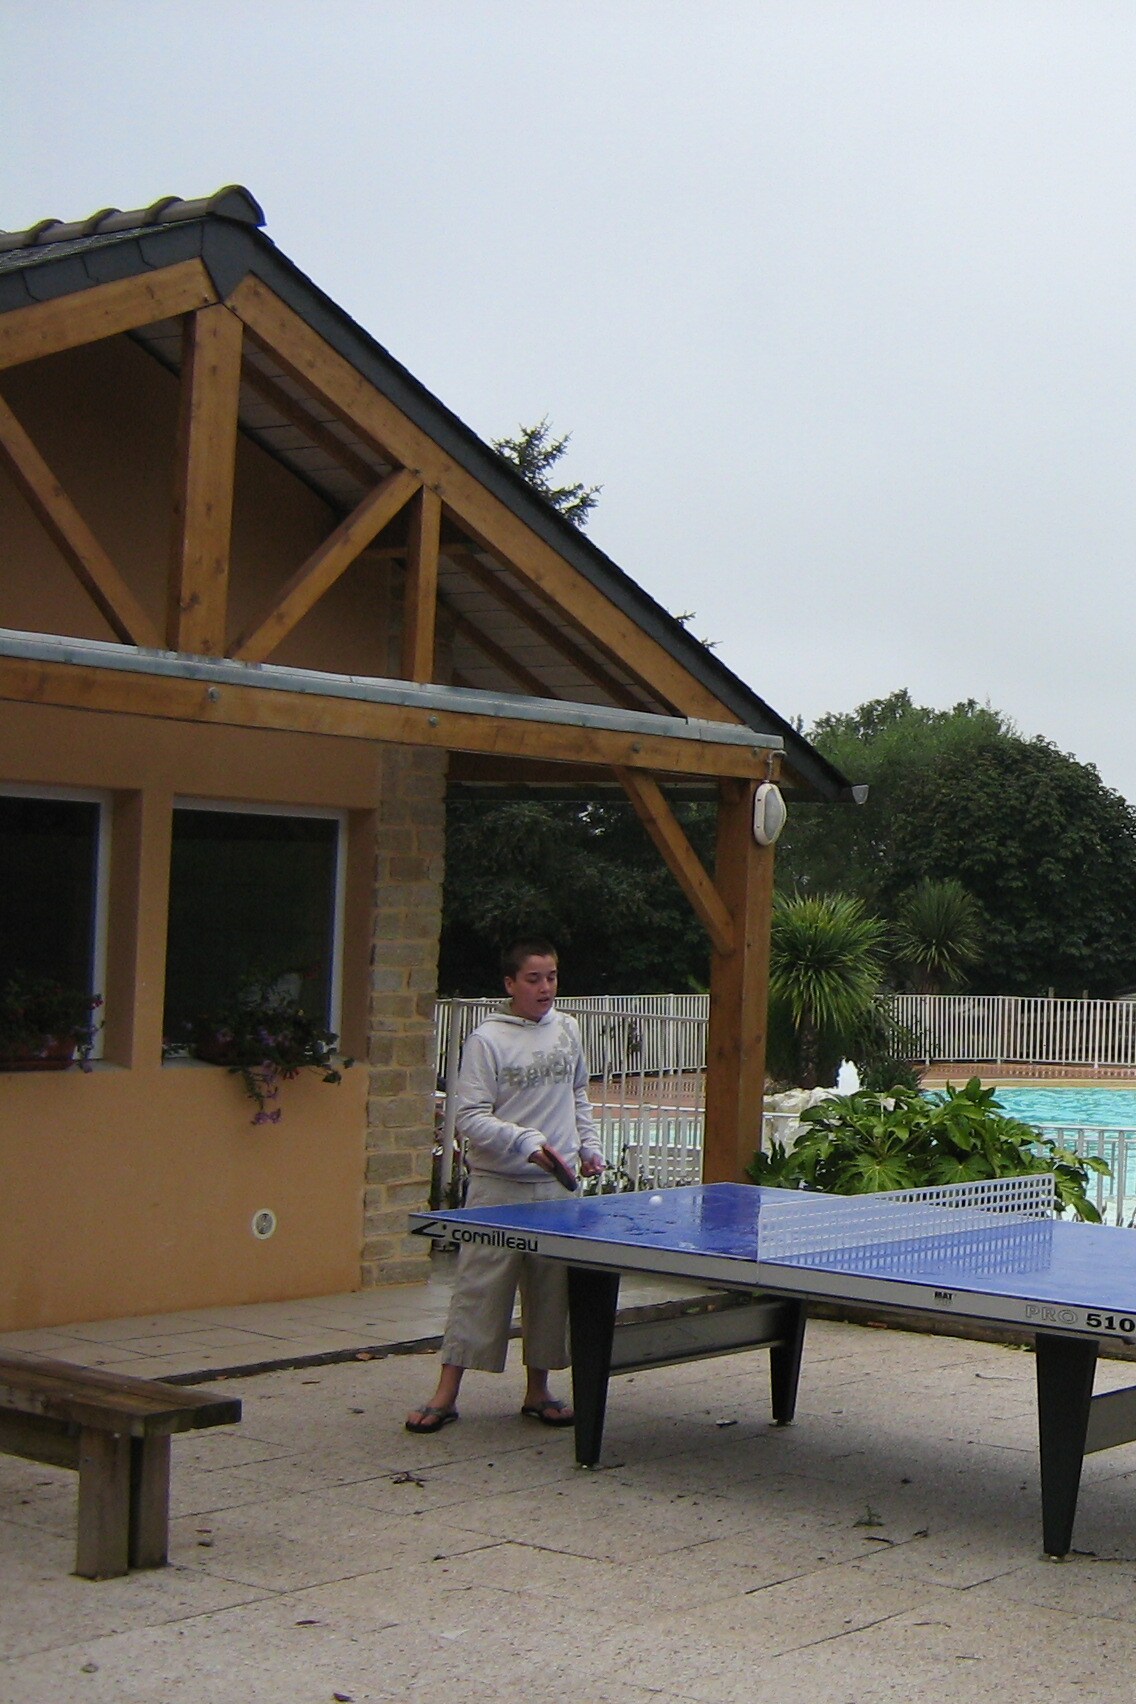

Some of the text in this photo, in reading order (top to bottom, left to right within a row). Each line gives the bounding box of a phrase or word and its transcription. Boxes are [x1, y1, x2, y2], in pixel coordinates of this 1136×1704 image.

[452, 1228, 538, 1252] cornilleau
[1025, 1304, 1078, 1324] PRO
[1086, 1313, 1135, 1332] 510
